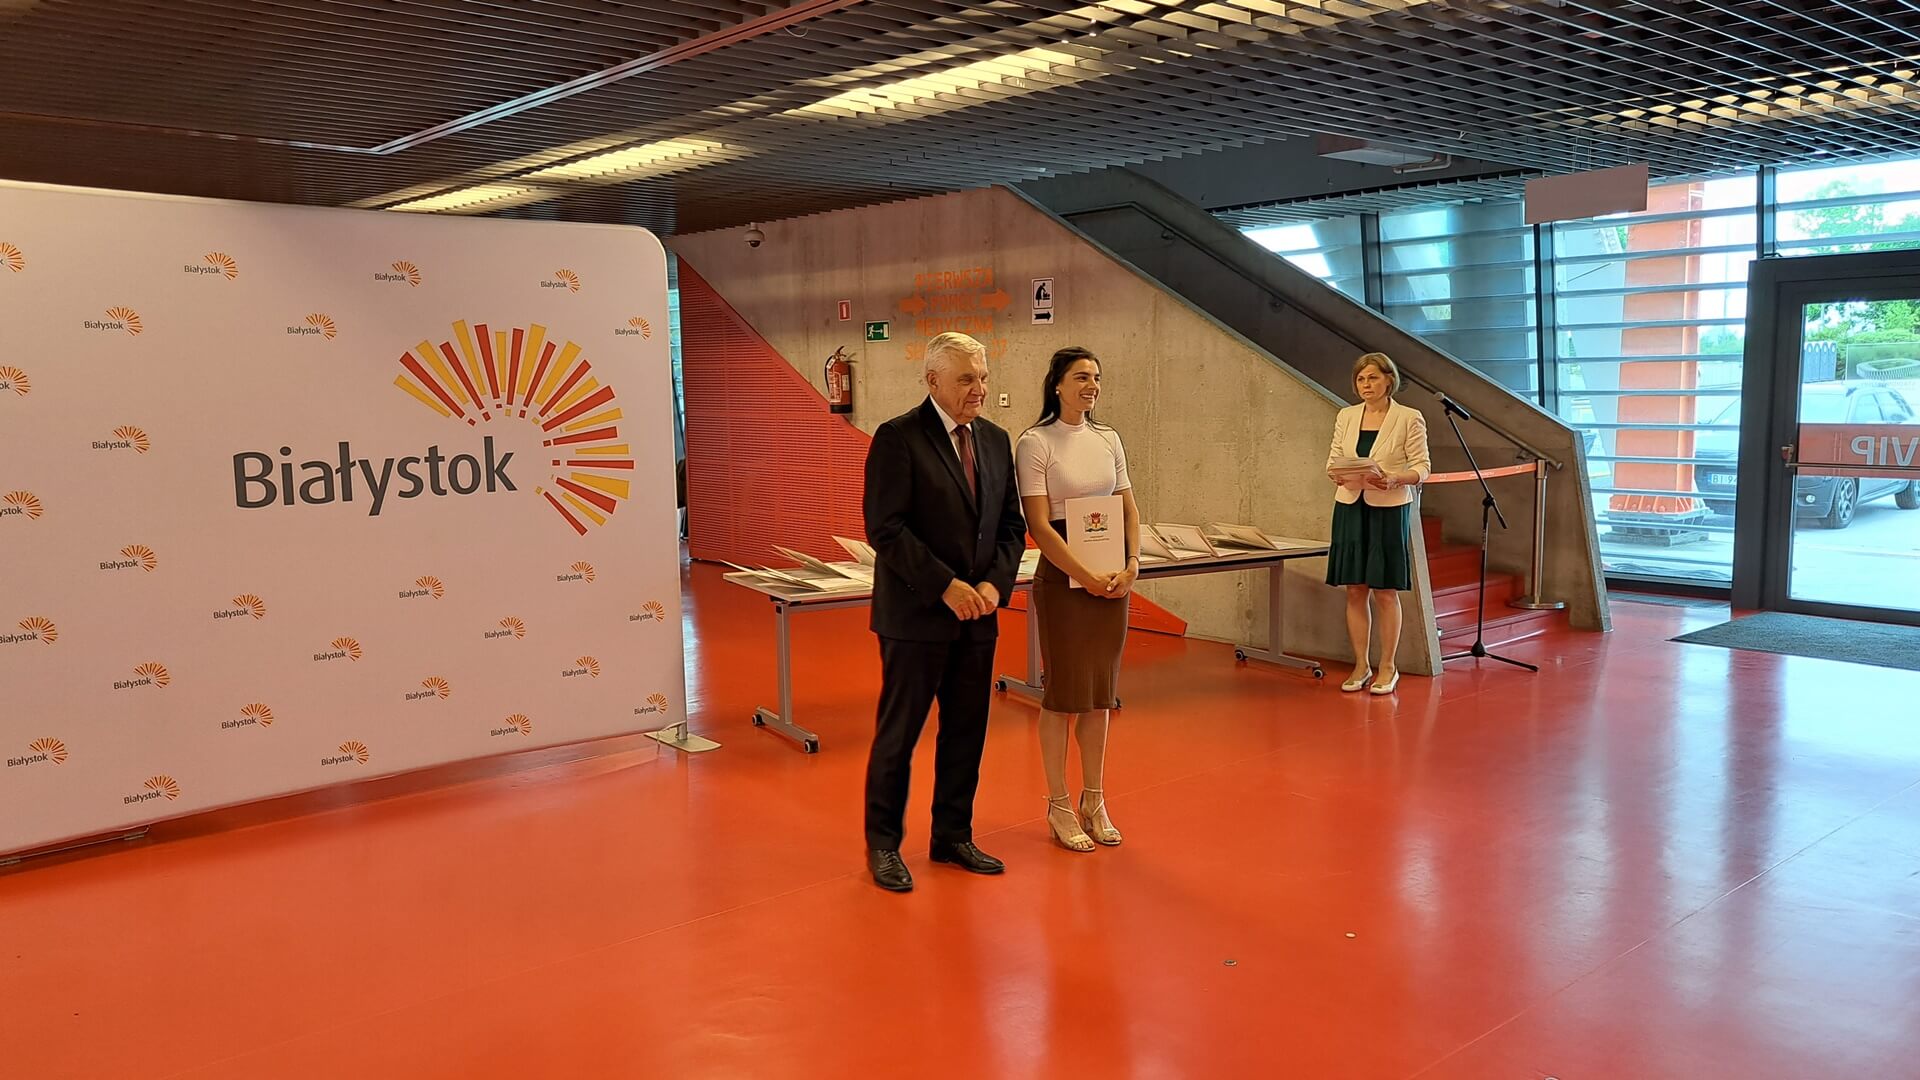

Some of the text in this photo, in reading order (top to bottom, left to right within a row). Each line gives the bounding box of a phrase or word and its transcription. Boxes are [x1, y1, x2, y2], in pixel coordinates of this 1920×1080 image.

[184, 265, 221, 275] Białystok
[374, 272, 406, 282] Białystok
[914, 267, 993, 291] PIERWSZA
[84, 320, 124, 332] Białystok
[286, 326, 321, 337] Białystok
[92, 439, 132, 451] Białystok
[233, 436, 518, 516] Białystok
[99, 559, 139, 571] Białystok
[398, 589, 430, 600] Białystok
[213, 608, 249, 621] Białystok
[313, 649, 346, 663] Białystok
[113, 676, 152, 691] Białystok
[405, 688, 437, 702] Białystok
[221, 716, 258, 731] Białystok
[7, 752, 49, 768] Białystok
[321, 754, 353, 767] Białystok
[123, 790, 163, 805] Białystok
